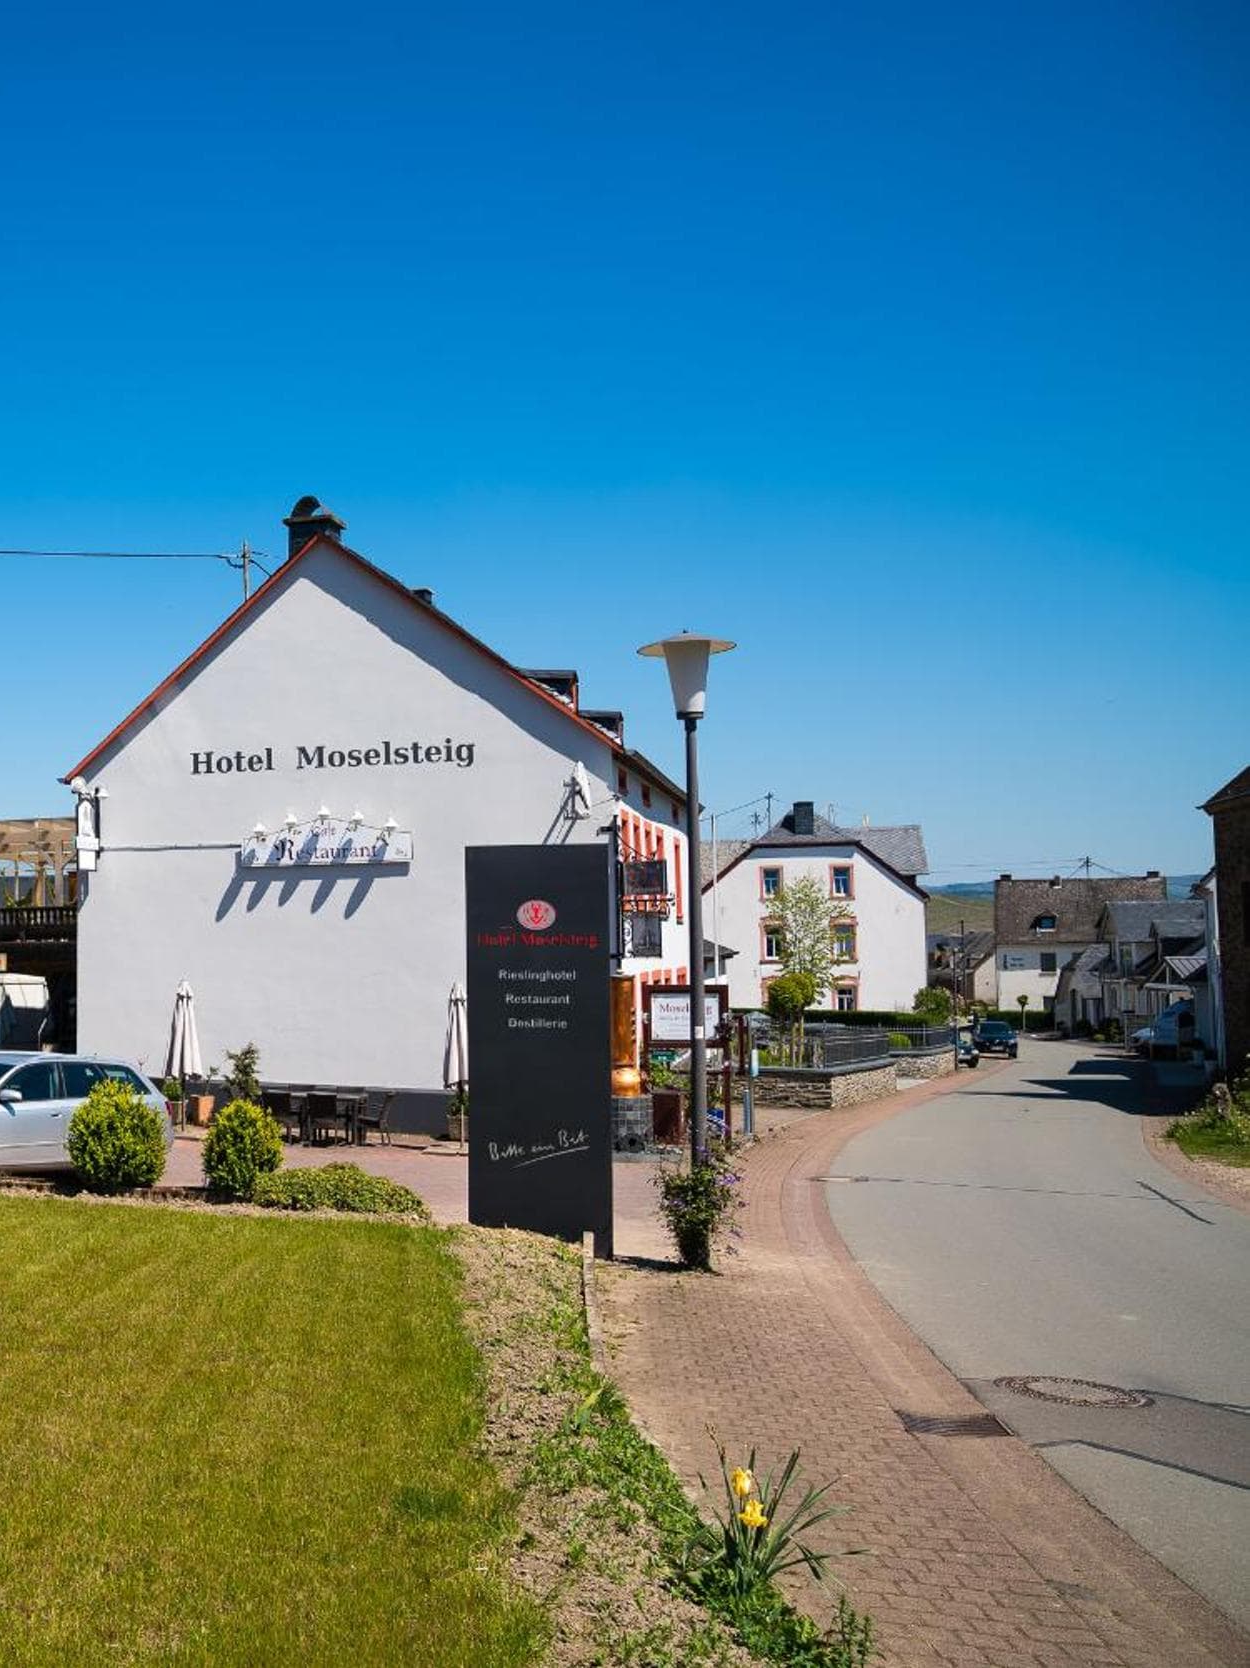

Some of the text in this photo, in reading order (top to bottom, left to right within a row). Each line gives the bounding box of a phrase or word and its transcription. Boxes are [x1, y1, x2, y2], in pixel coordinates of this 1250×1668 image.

[190, 738, 476, 775] Hotel Moselsteig
[274, 838, 379, 861] Restaurant
[498, 969, 577, 983] Rieslinghotel
[506, 993, 570, 1005] Restaurant
[508, 1018, 568, 1029] Destillerie
